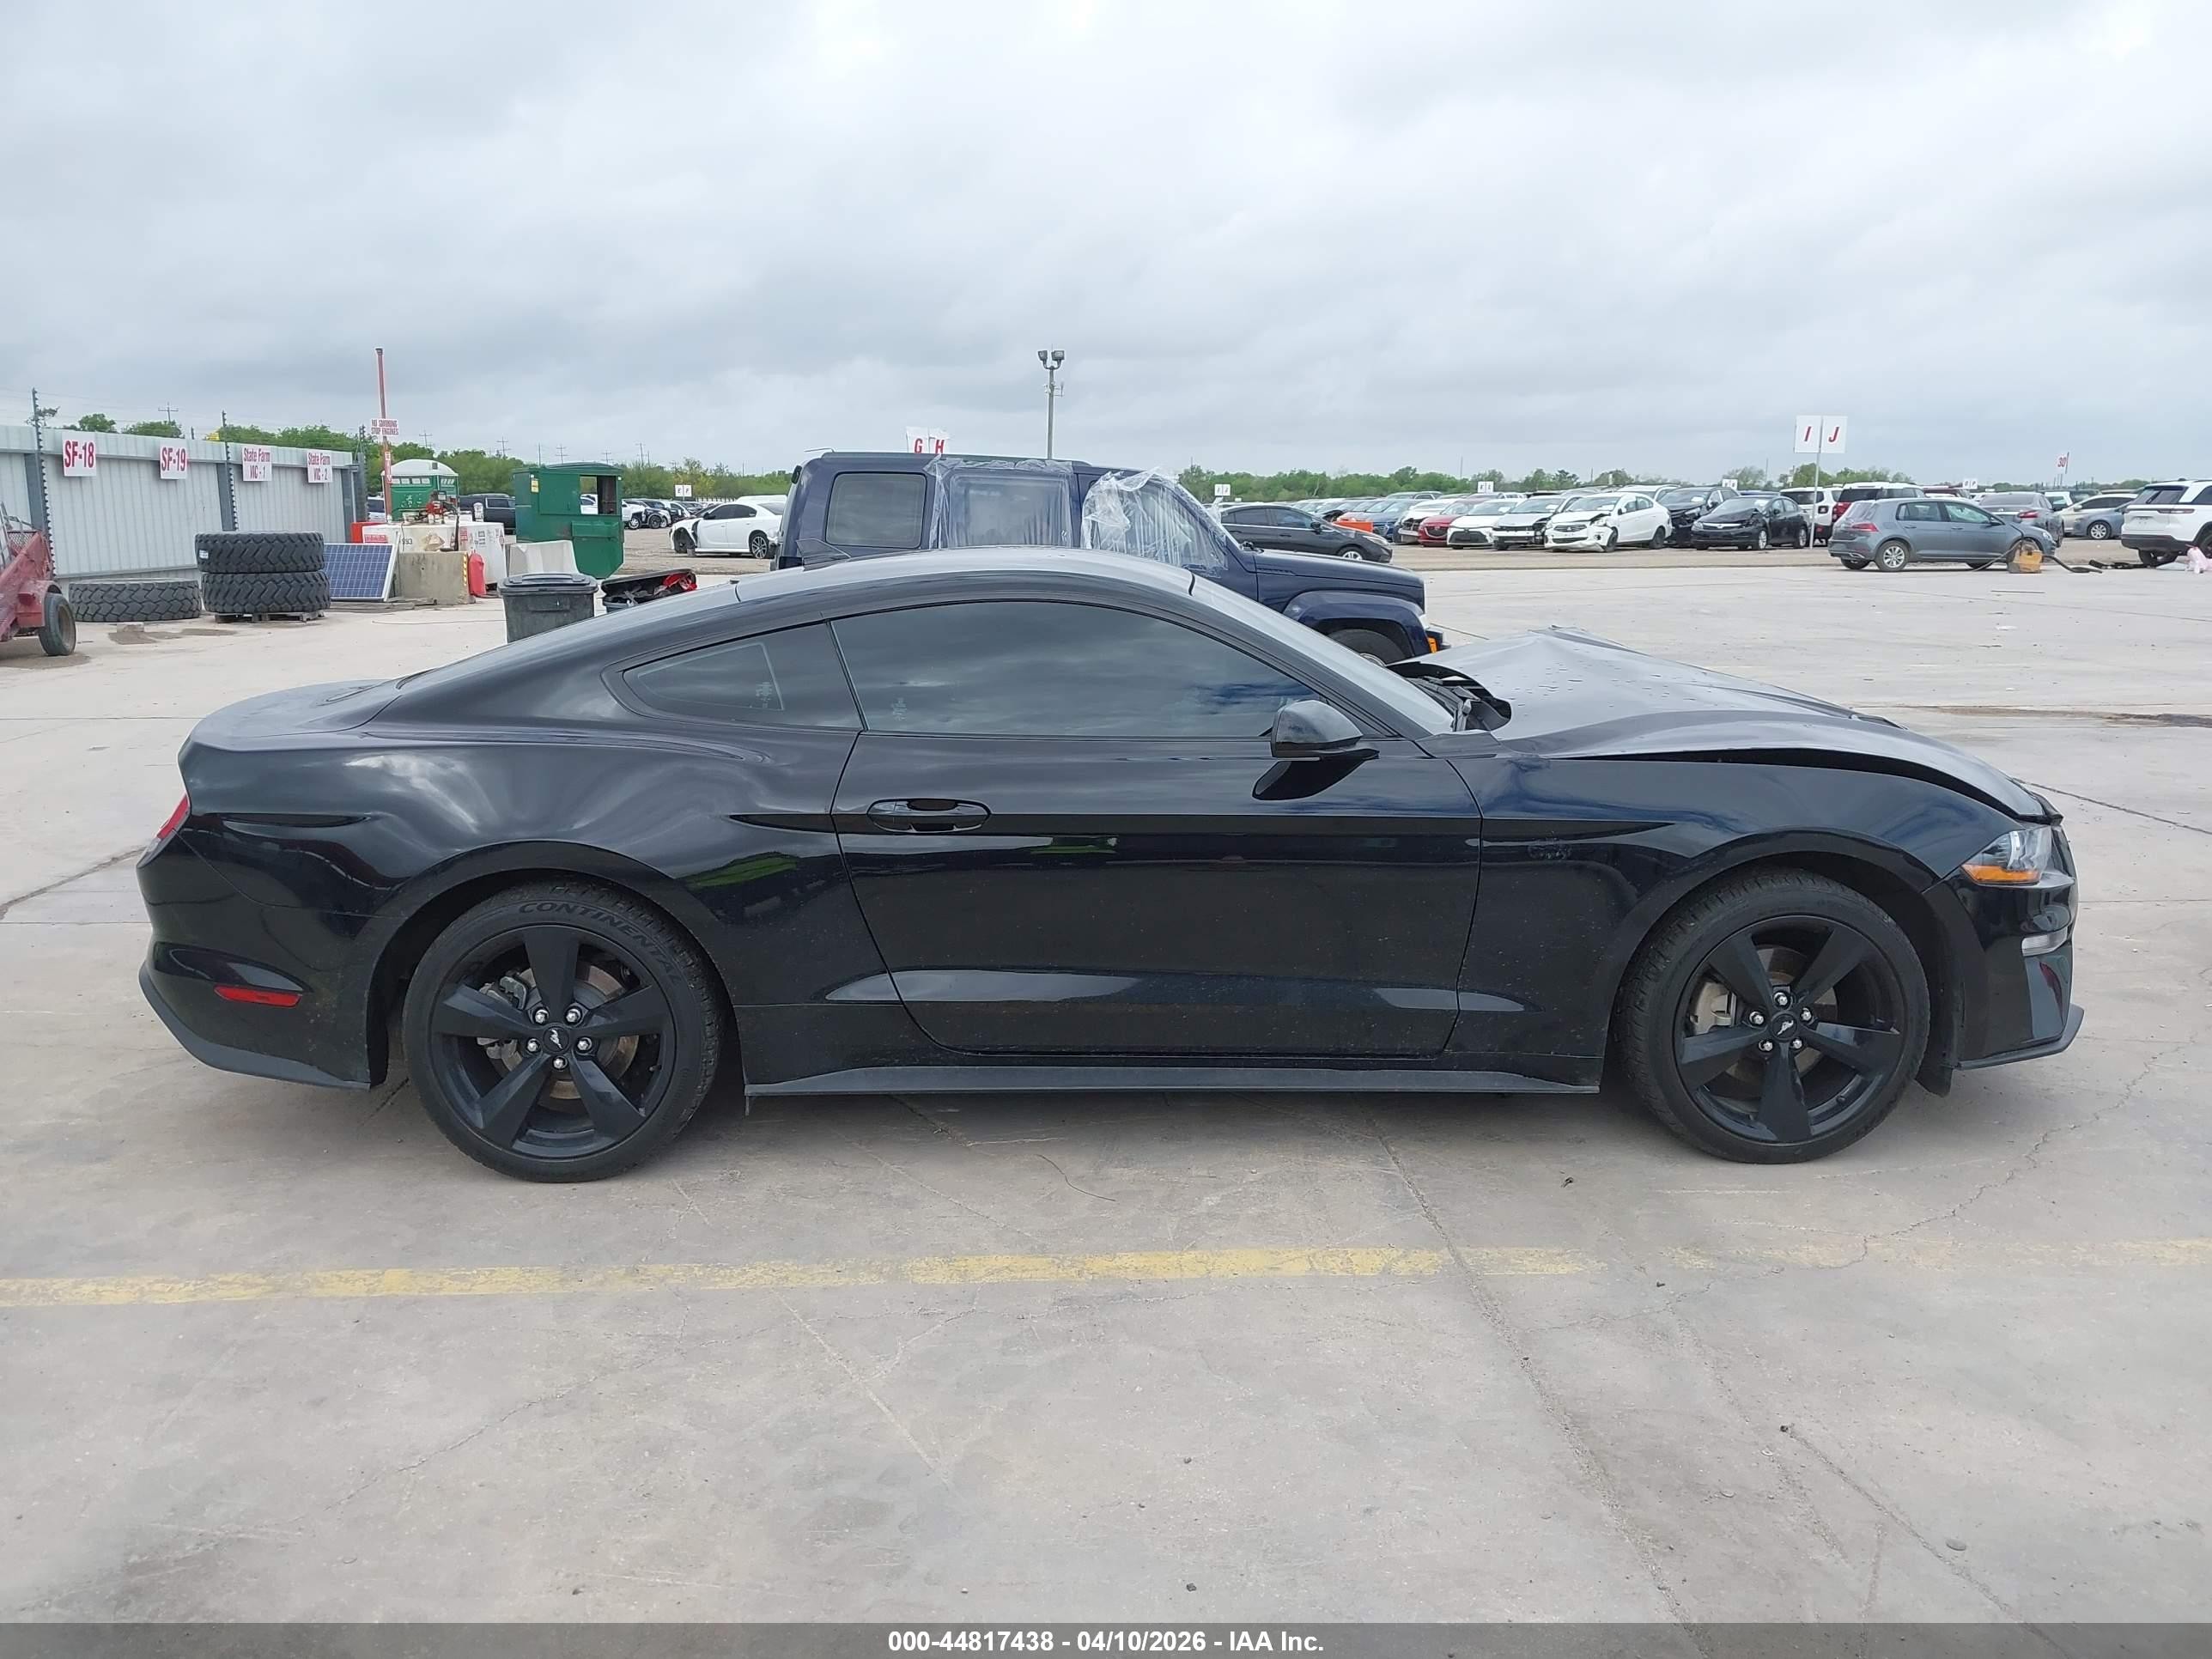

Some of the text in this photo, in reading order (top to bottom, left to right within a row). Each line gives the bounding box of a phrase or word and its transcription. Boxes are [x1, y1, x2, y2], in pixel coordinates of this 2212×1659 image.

[1804, 426, 1839, 442] I J
[64, 440, 94, 468] SF-18
[914, 438, 945, 454] G H
[161, 447, 186, 471] SF-19
[243, 447, 270, 462] State Farm
[308, 453, 331, 465] State Farm
[519, 902, 683, 985] CONTINENTAL
